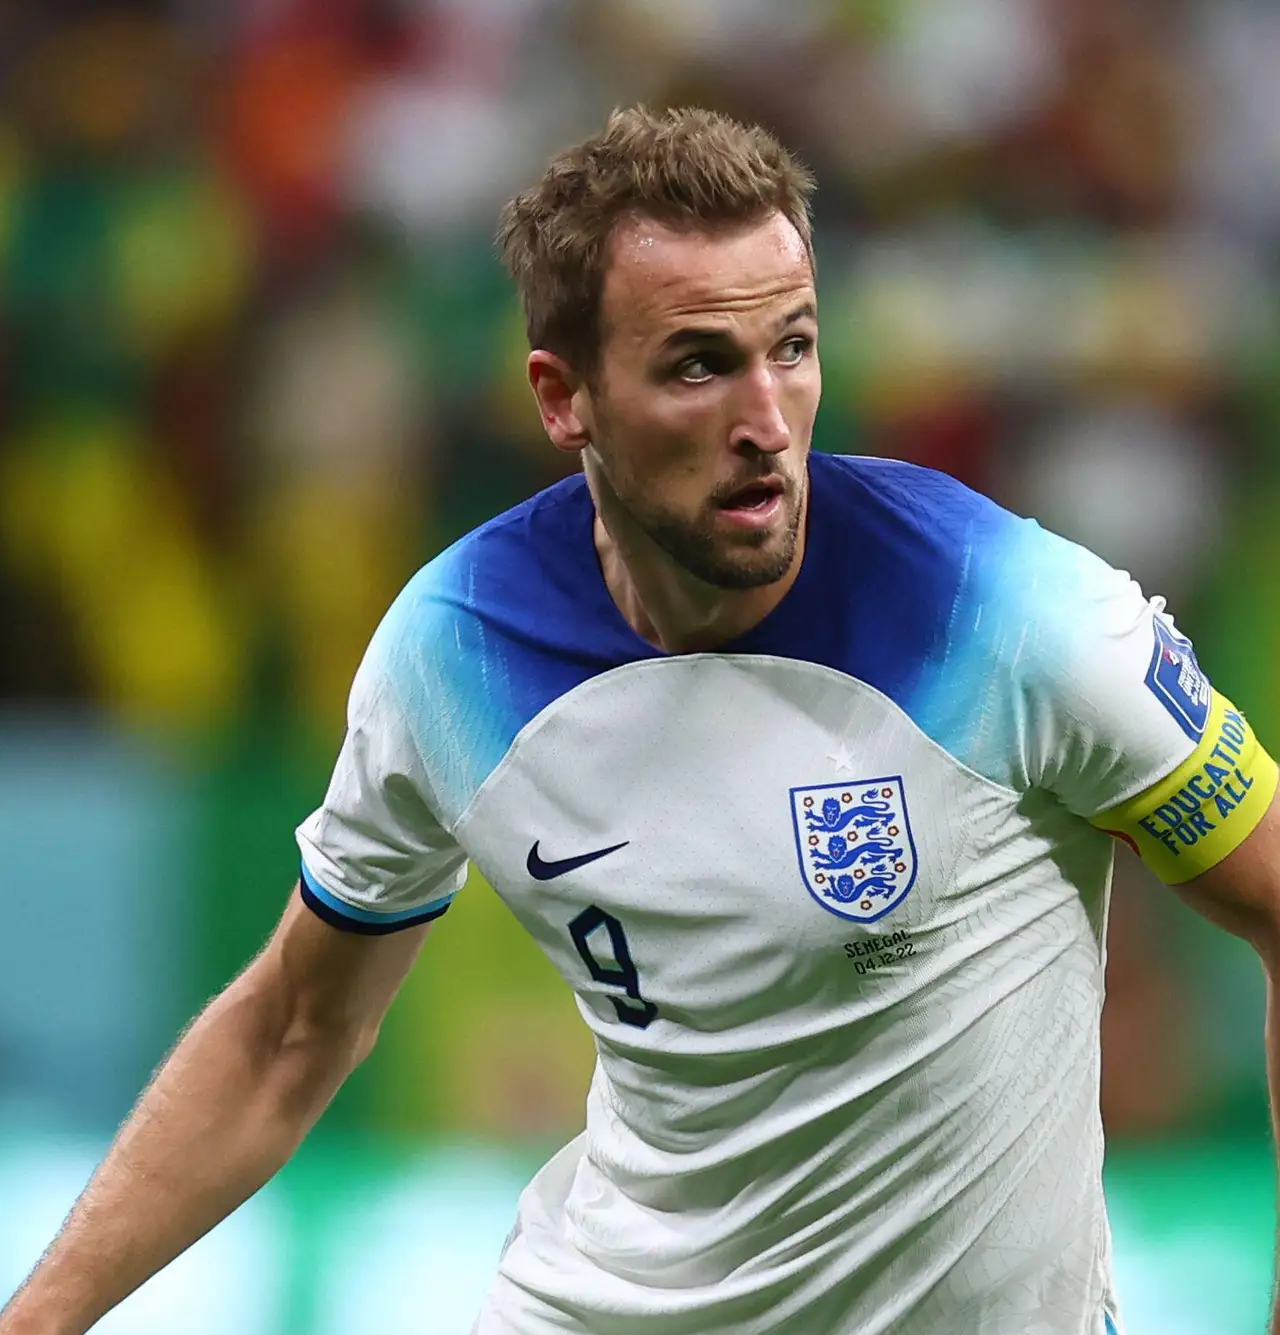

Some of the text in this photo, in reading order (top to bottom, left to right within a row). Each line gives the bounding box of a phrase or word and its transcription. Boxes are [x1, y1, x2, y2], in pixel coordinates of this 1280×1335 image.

[1138, 709, 1246, 839] EDUCATION
[1160, 768, 1254, 857] FOR ALL
[567, 904, 659, 1031] 9
[844, 929, 911, 959] SENEGAL
[854, 942, 917, 975] 04.12.22
